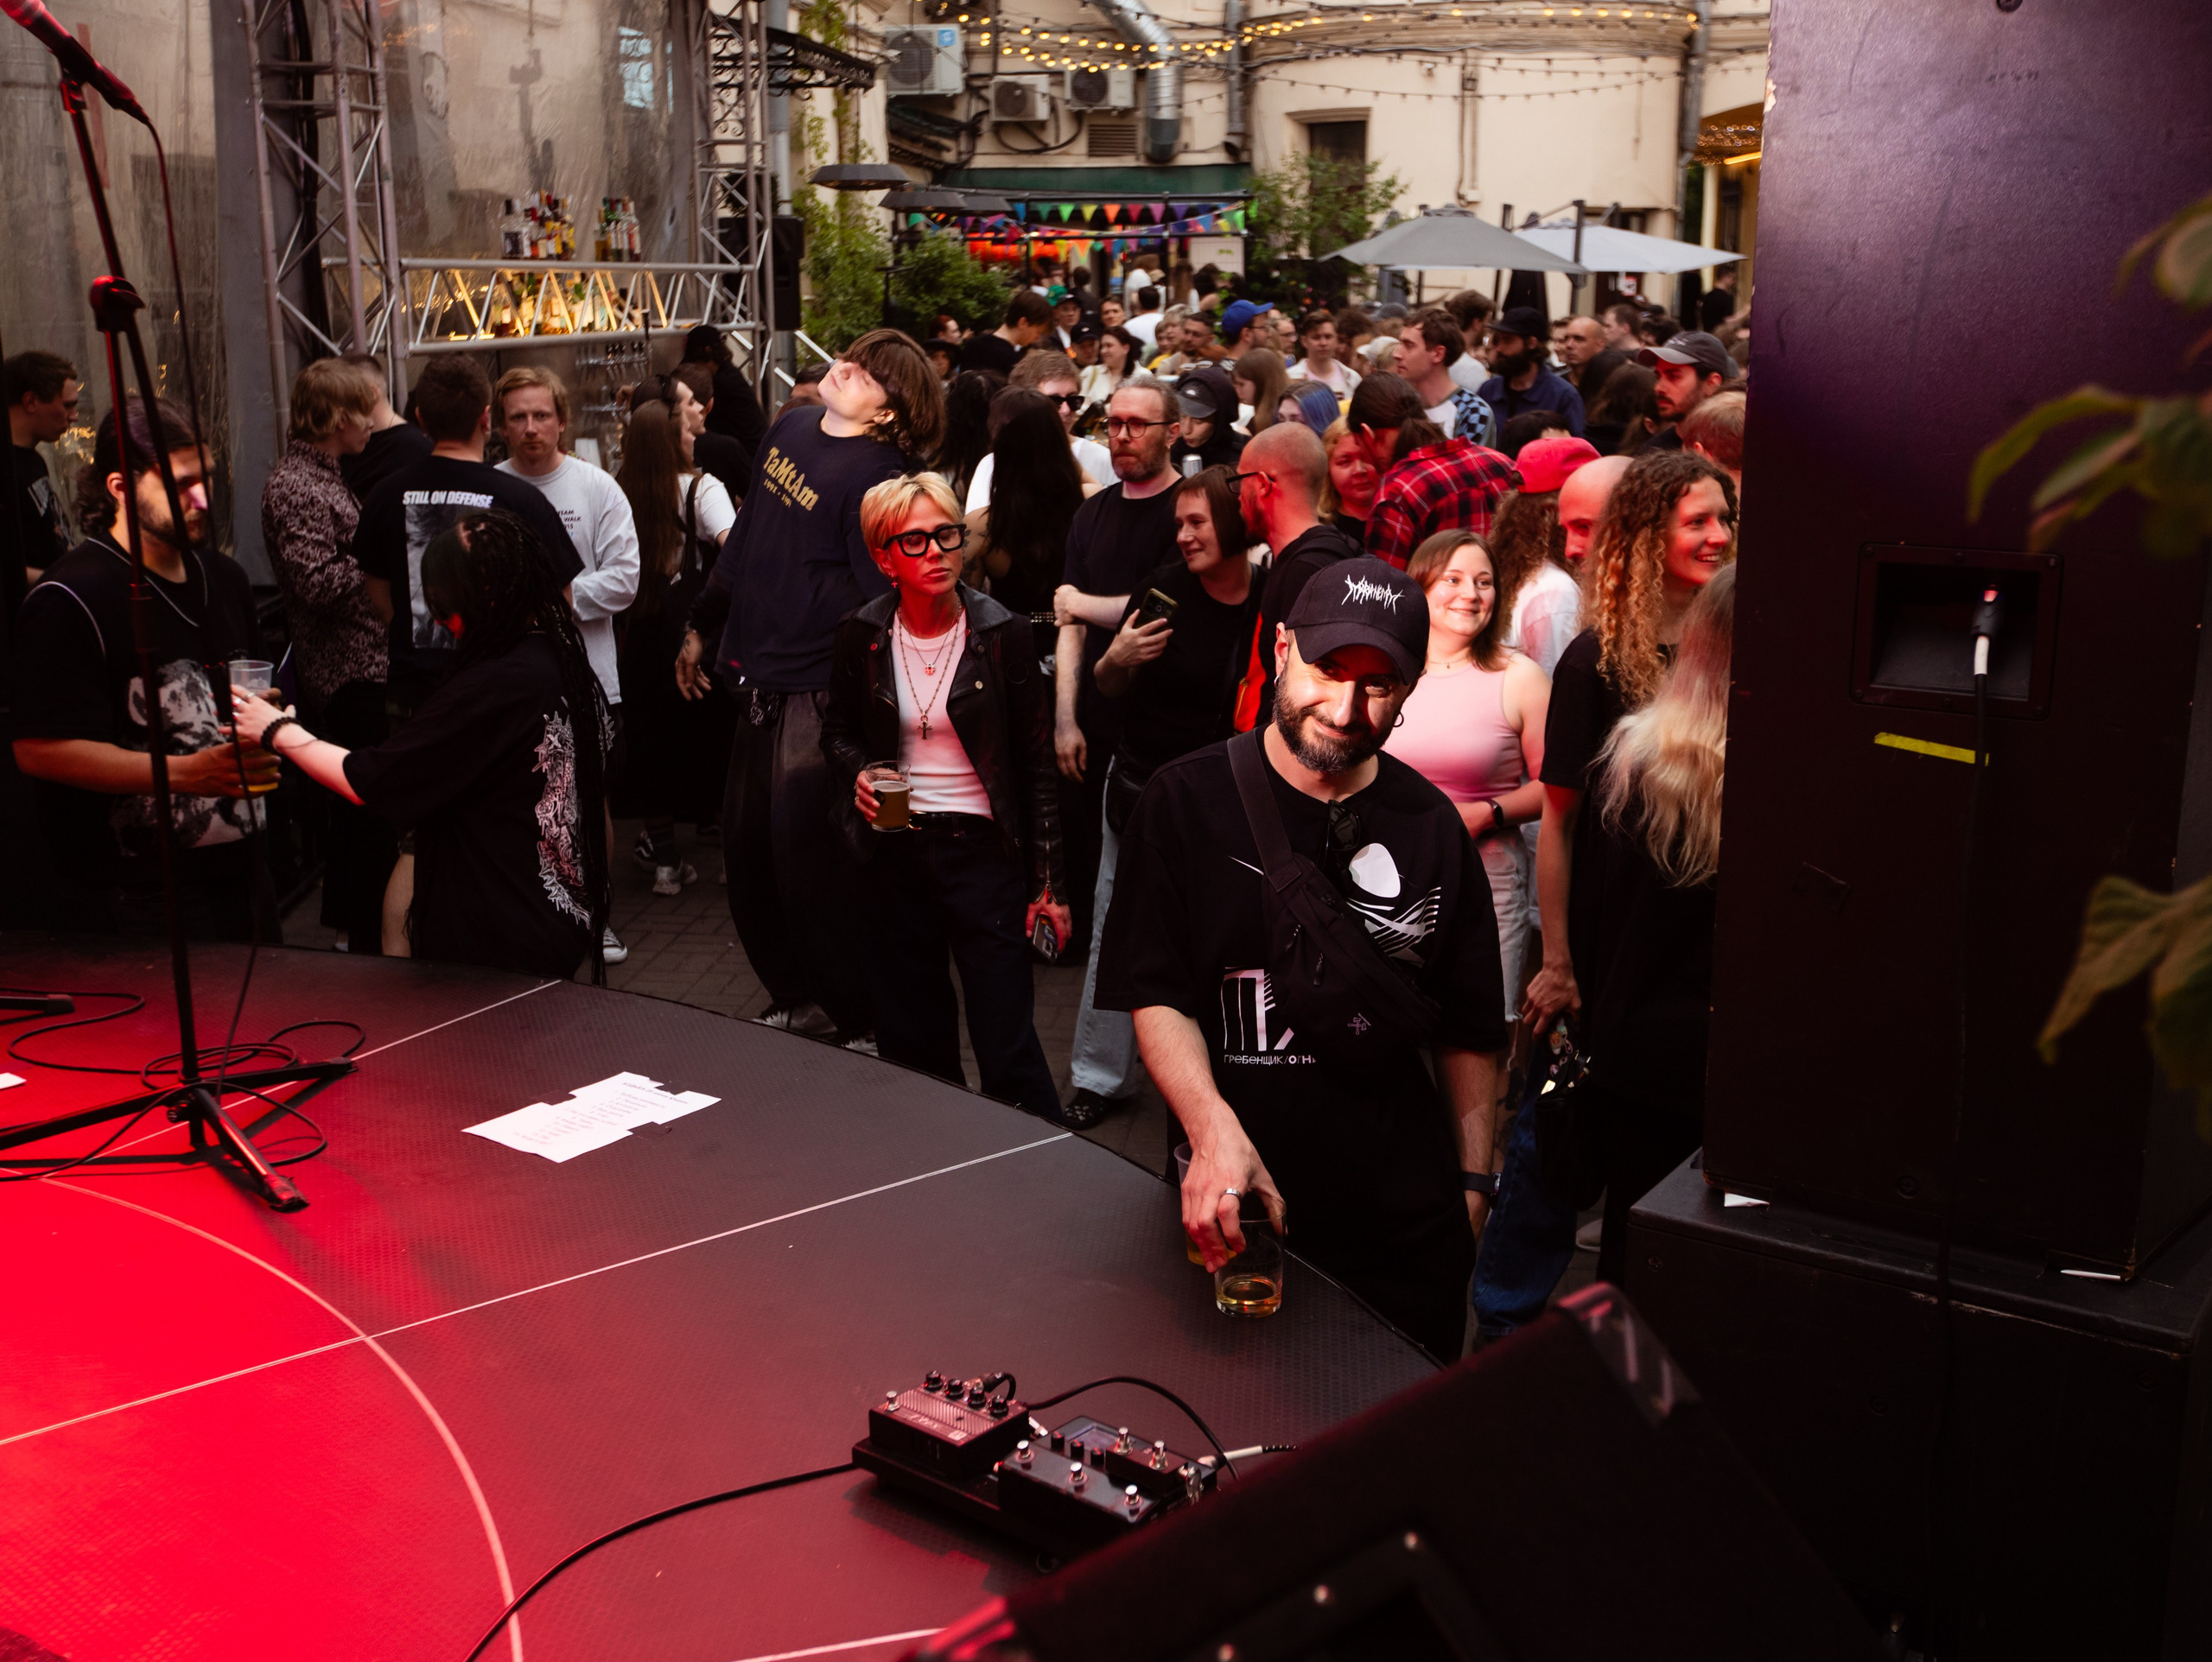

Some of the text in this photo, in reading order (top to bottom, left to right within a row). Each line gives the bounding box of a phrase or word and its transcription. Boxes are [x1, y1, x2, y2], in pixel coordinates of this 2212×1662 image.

[763, 446, 819, 511] TaMtAm
[403, 491, 493, 509] STILL ON DEFENSE
